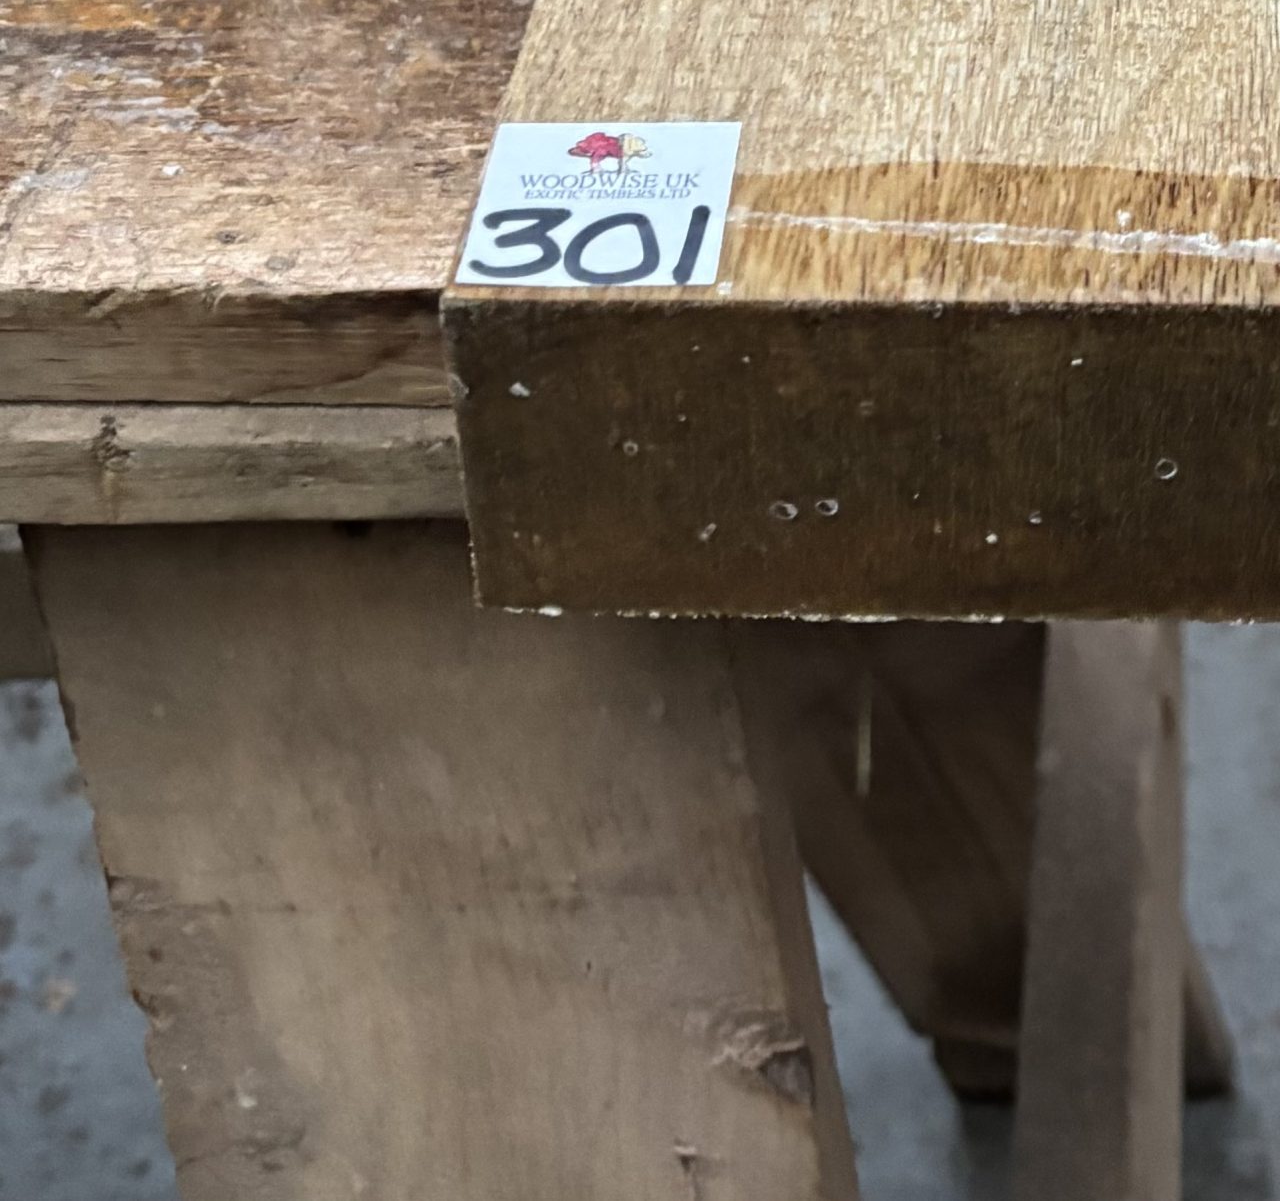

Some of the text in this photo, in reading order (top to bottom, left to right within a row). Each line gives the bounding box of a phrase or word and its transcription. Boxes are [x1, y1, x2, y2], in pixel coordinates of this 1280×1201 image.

[520, 173, 700, 189] WOODWISE UK
[524, 188, 691, 200] EXOTIC TIMBERS LTD
[469, 204, 711, 285] 301
